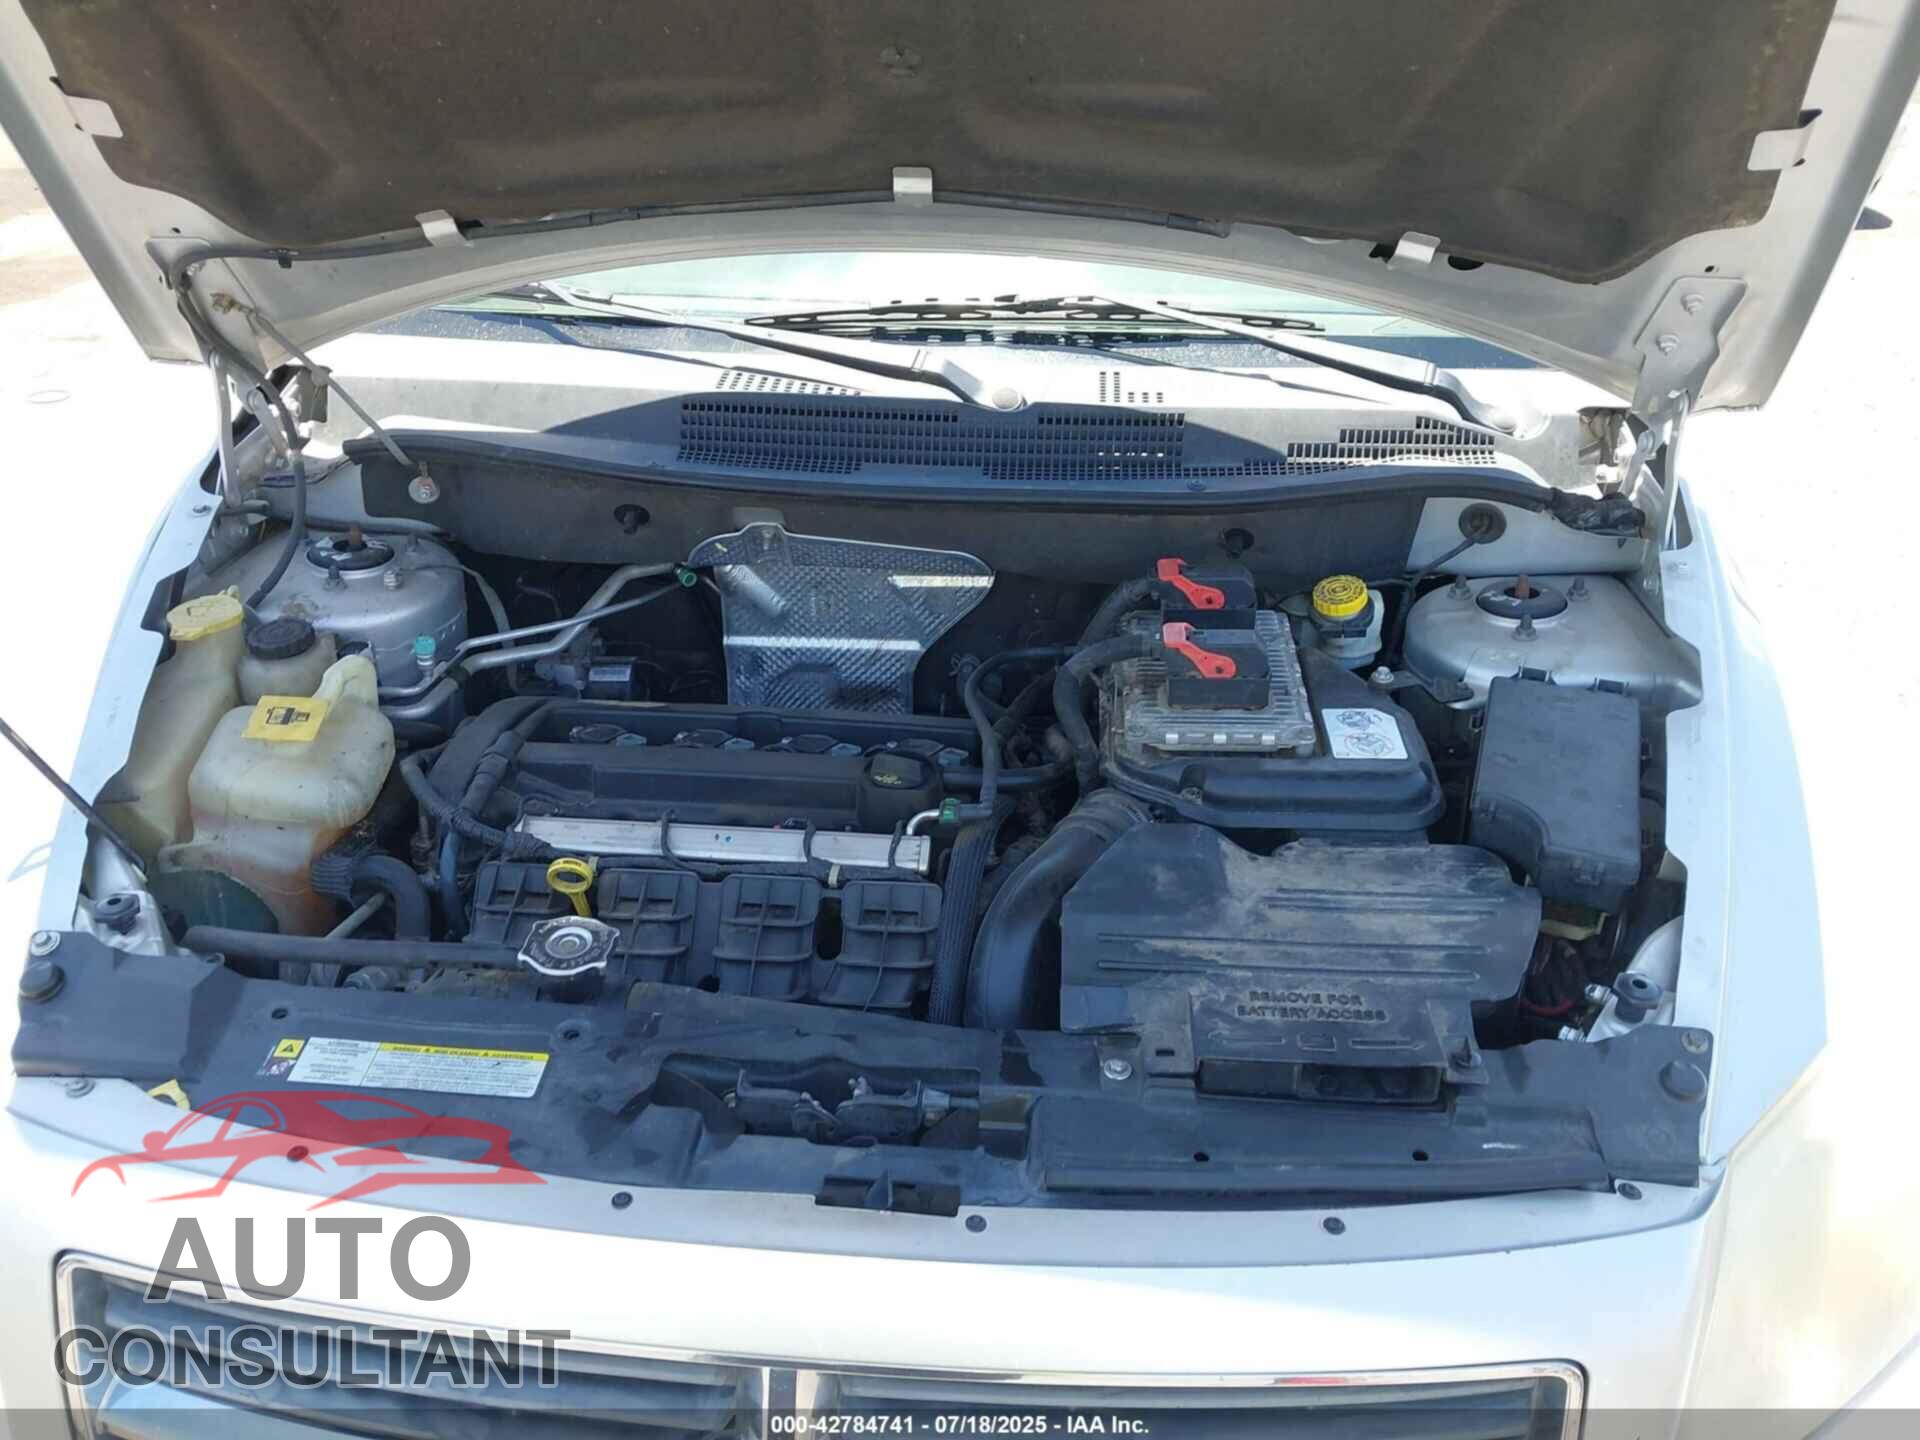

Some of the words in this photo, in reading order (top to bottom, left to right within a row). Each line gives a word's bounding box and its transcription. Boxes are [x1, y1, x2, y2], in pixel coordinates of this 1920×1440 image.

[1249, 990, 1322, 1005] REMOVE
[1327, 993, 1363, 1006] FOR
[1237, 1005, 1309, 1020] BATTERY
[1317, 1007, 1387, 1021] ACCESS
